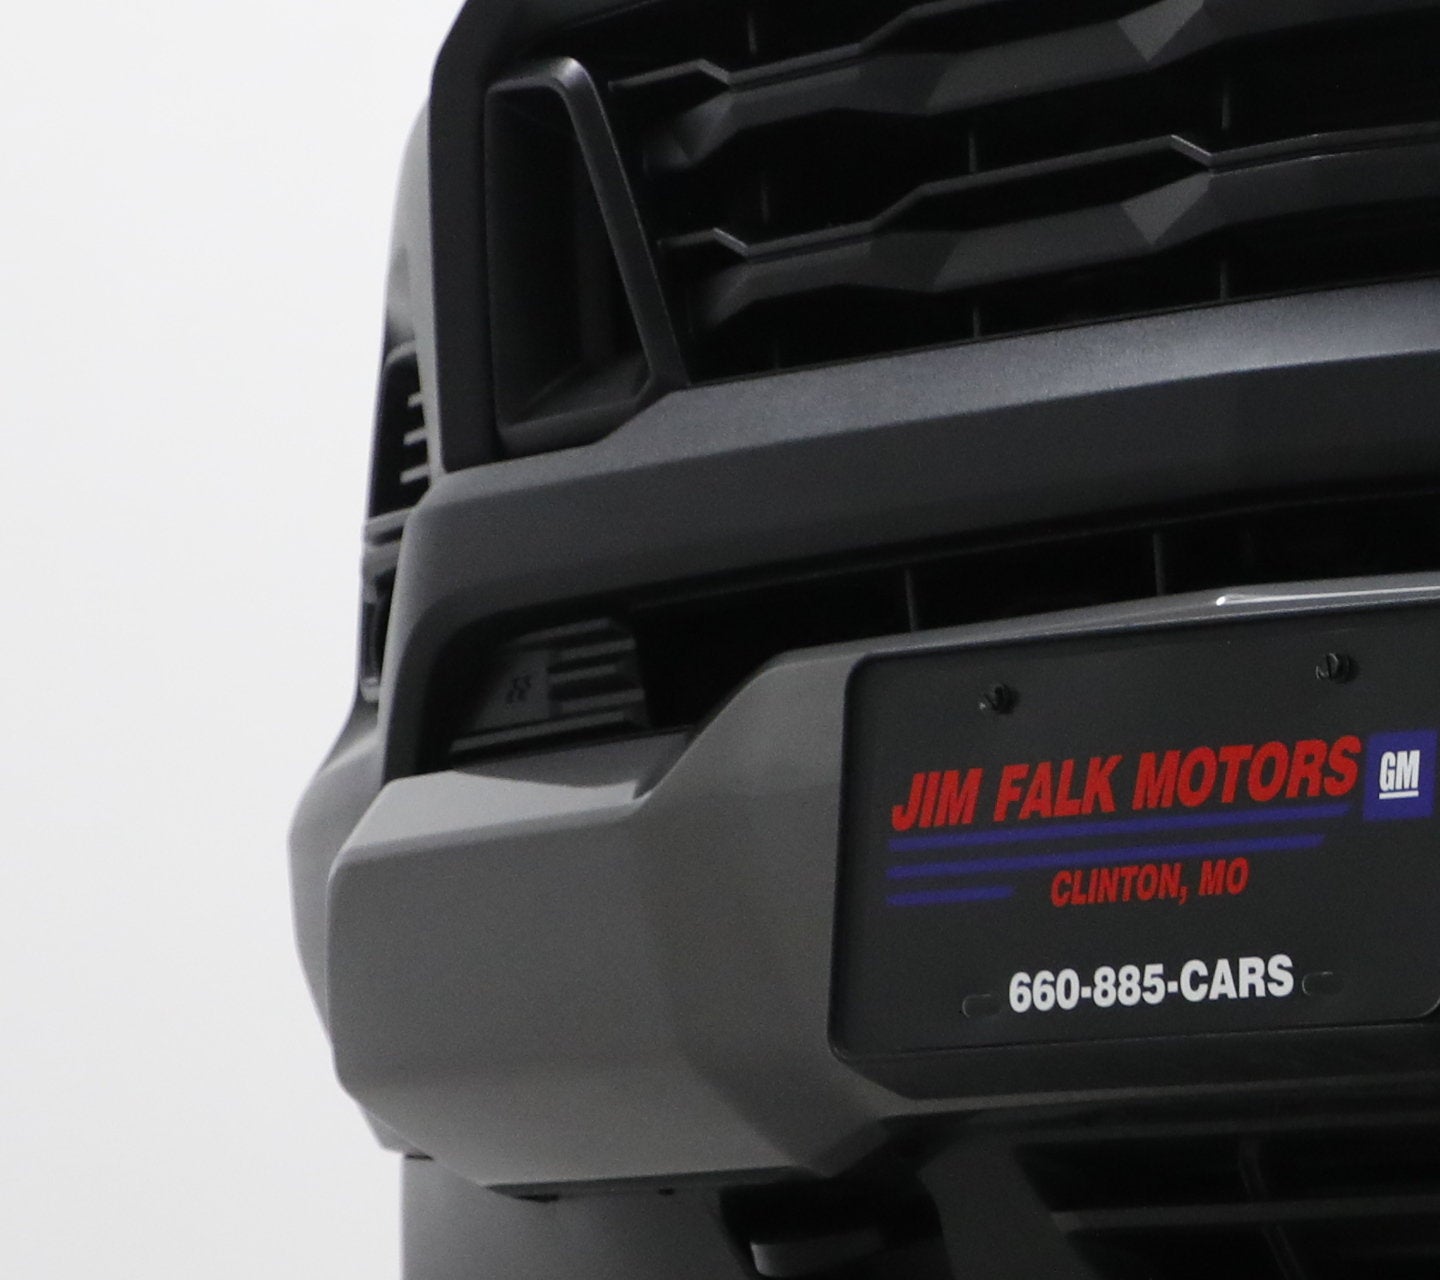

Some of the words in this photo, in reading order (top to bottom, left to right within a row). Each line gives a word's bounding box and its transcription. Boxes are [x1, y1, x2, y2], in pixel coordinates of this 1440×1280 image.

[891, 768, 984, 831] JIM
[993, 755, 1123, 822] FALK
[1132, 735, 1362, 810] MOTORS
[1379, 750, 1421, 793] GM
[1050, 861, 1188, 907] CLINTON,
[1199, 857, 1250, 896] MO
[1008, 954, 1294, 1013] 660-885-CARS
